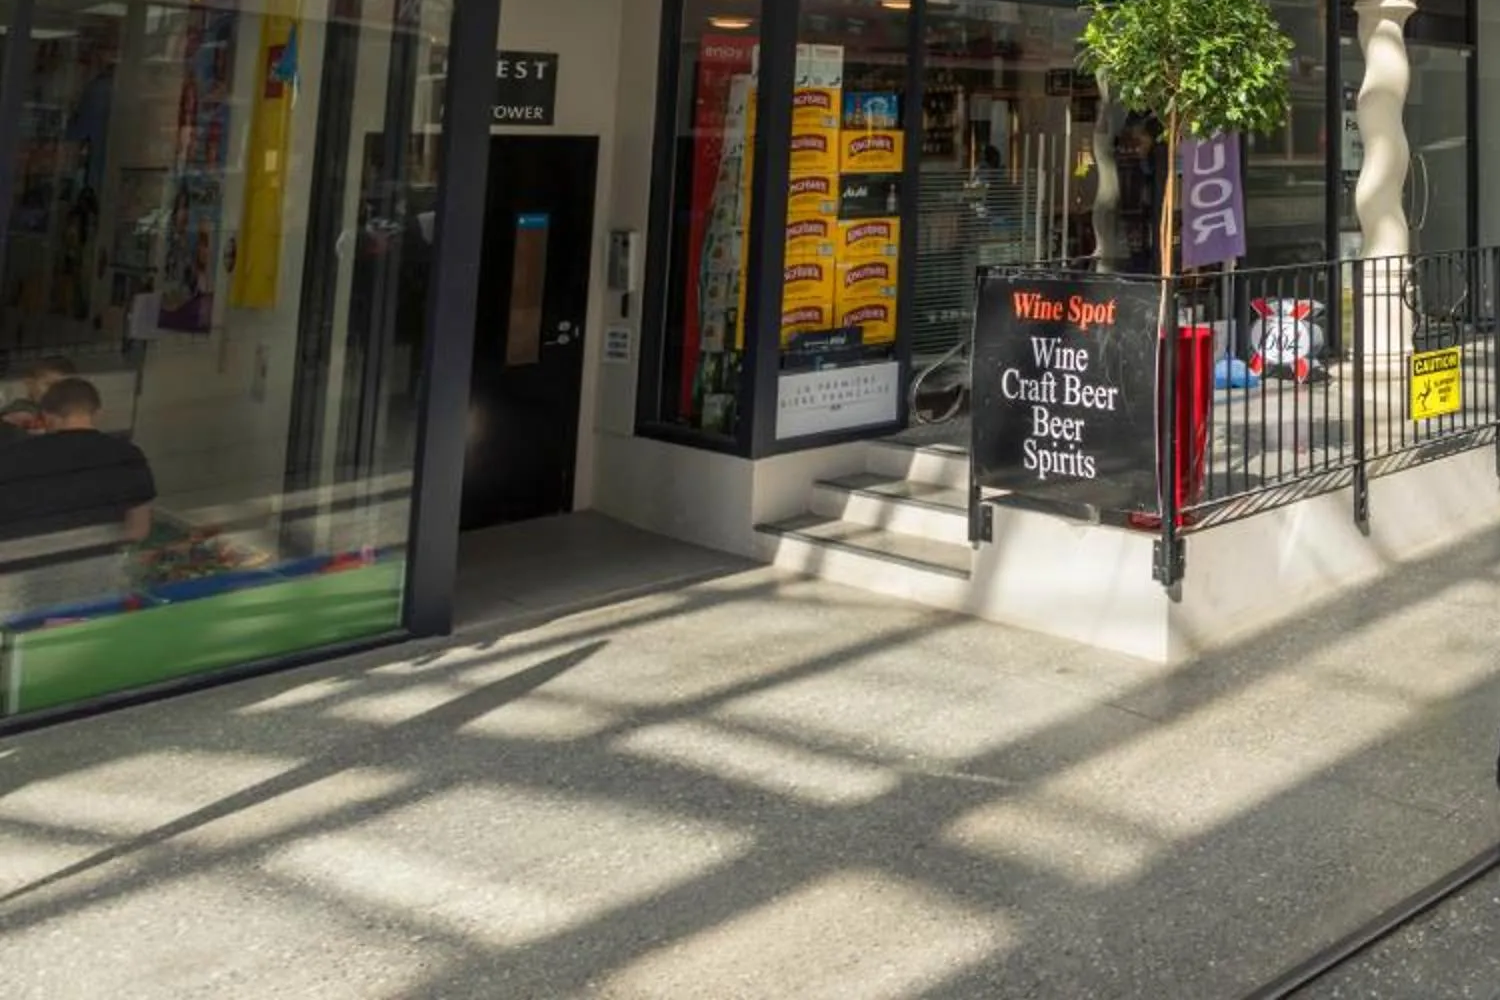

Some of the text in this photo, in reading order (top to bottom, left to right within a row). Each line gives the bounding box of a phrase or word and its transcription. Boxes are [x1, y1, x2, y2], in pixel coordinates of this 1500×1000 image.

[496, 60, 548, 79] EST
[493, 105, 544, 120] OWER
[1012, 290, 1064, 322] Wine
[1067, 295, 1117, 332] Spot
[1030, 336, 1089, 373] Wine
[1415, 354, 1457, 375] CAUTION
[1001, 368, 1119, 411] Craft Beer
[1031, 405, 1085, 442] Beer
[1023, 439, 1097, 481] Spirits
